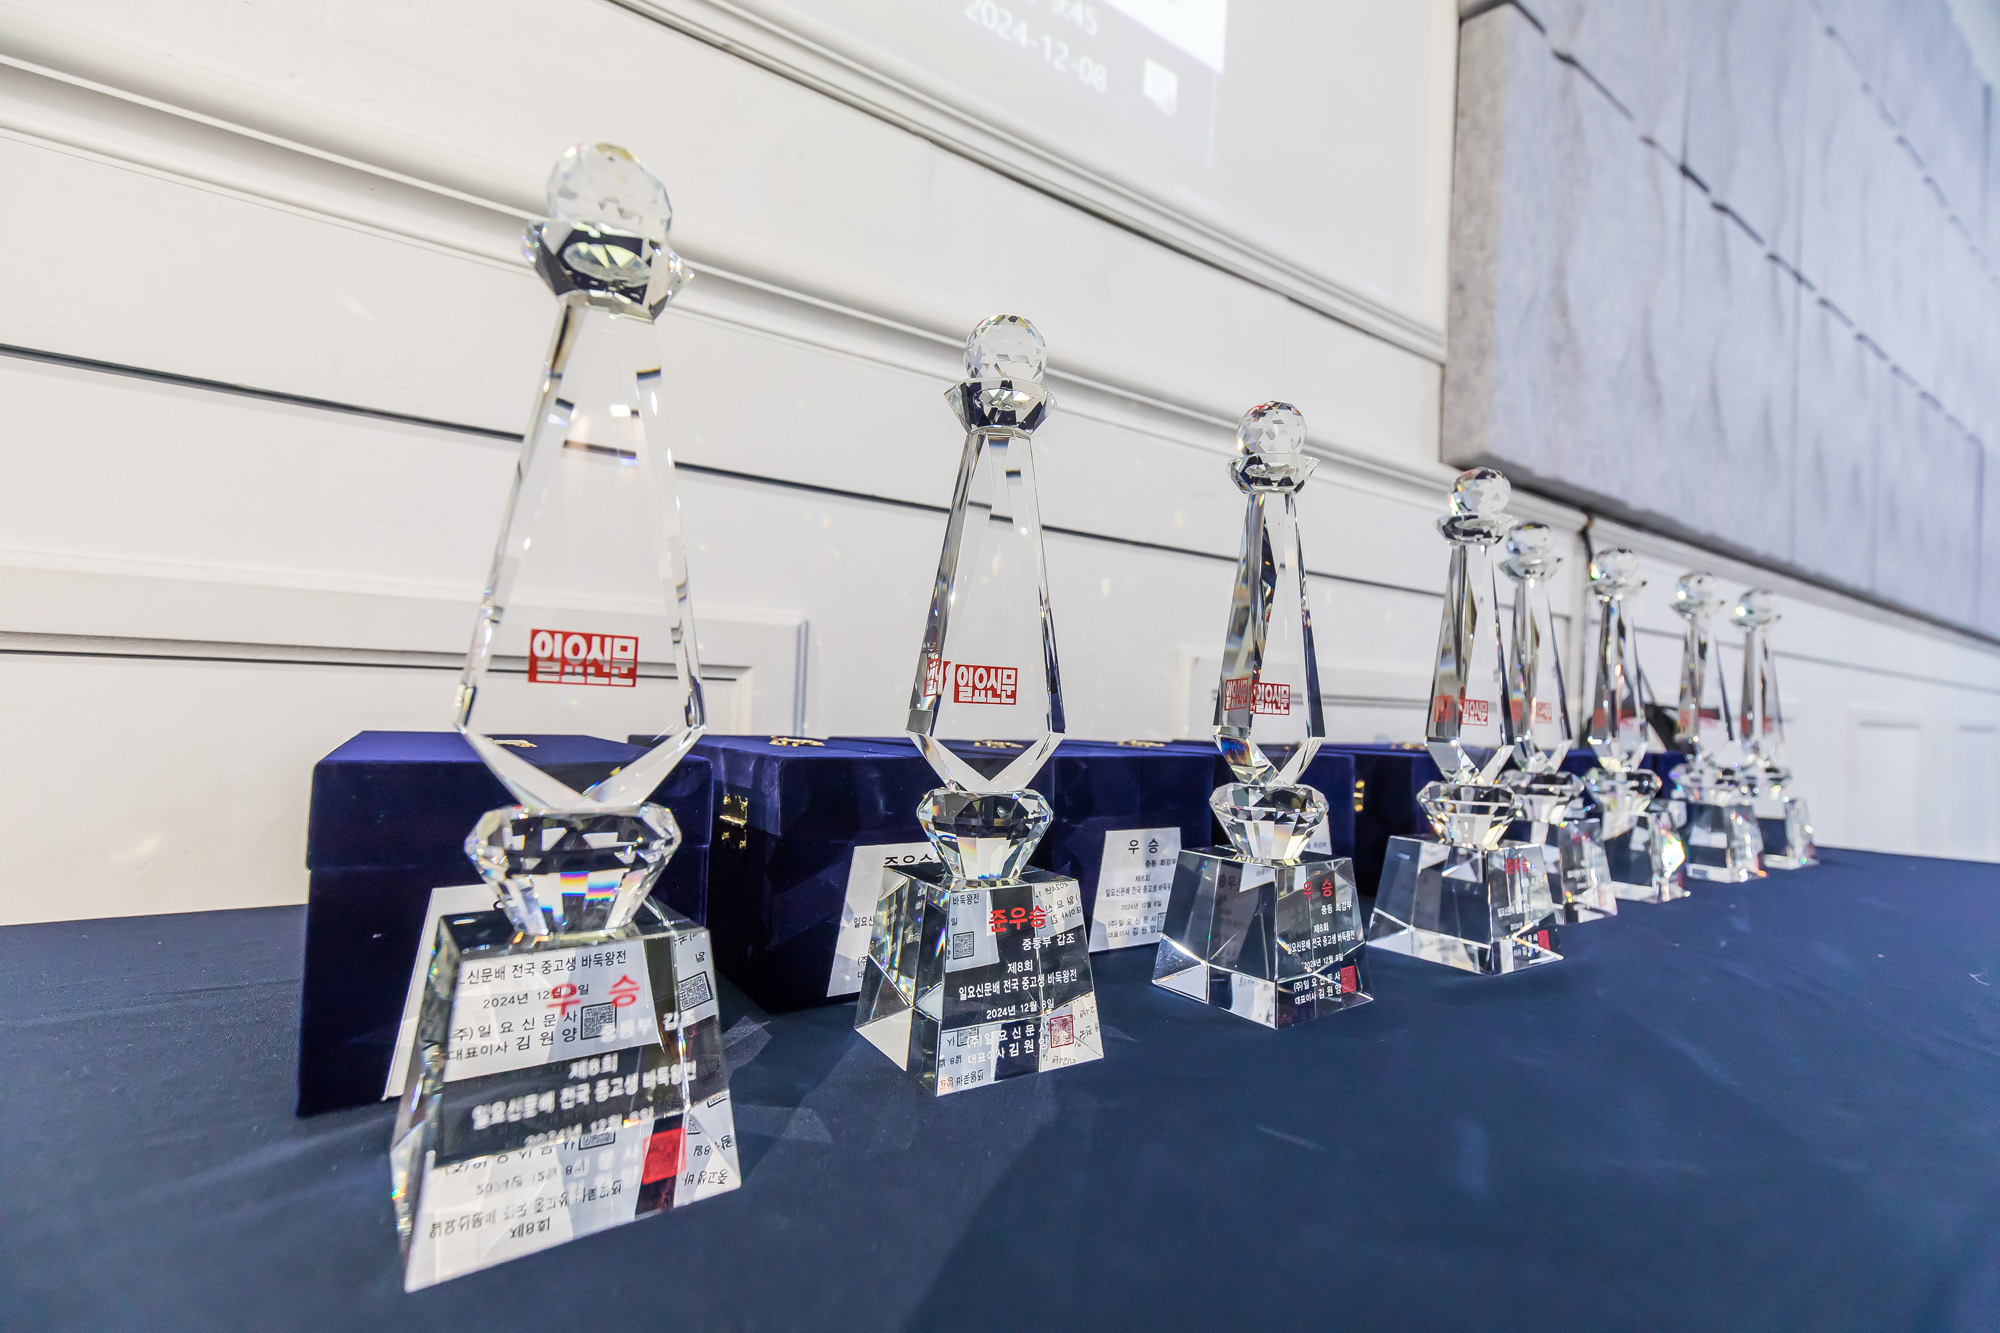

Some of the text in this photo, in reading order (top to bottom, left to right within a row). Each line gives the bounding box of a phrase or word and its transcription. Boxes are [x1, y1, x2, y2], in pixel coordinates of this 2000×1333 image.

[963, 0, 1108, 93] 2024-12-08
[528, 628, 638, 687] 일요신문
[953, 664, 1018, 705] 일요신문
[1254, 682, 1290, 715] 일요신문
[952, 893, 980, 906] 바둑왕전
[988, 904, 1047, 933] 준우승
[1021, 933, 1076, 951] 중등부 갑조
[512, 962, 535, 978] 전국
[541, 957, 577, 975] 중고생
[581, 950, 627, 968] 바둑왕전
[1007, 959, 1034, 974] 제8회
[958, 969, 1078, 1001] 일요신문배 전국 중고생 바둑왕전
[483, 992, 529, 1009] 2024년
[986, 998, 1055, 1019] 2024년 12월 8일
[448, 1041, 508, 1061] 대표이사
